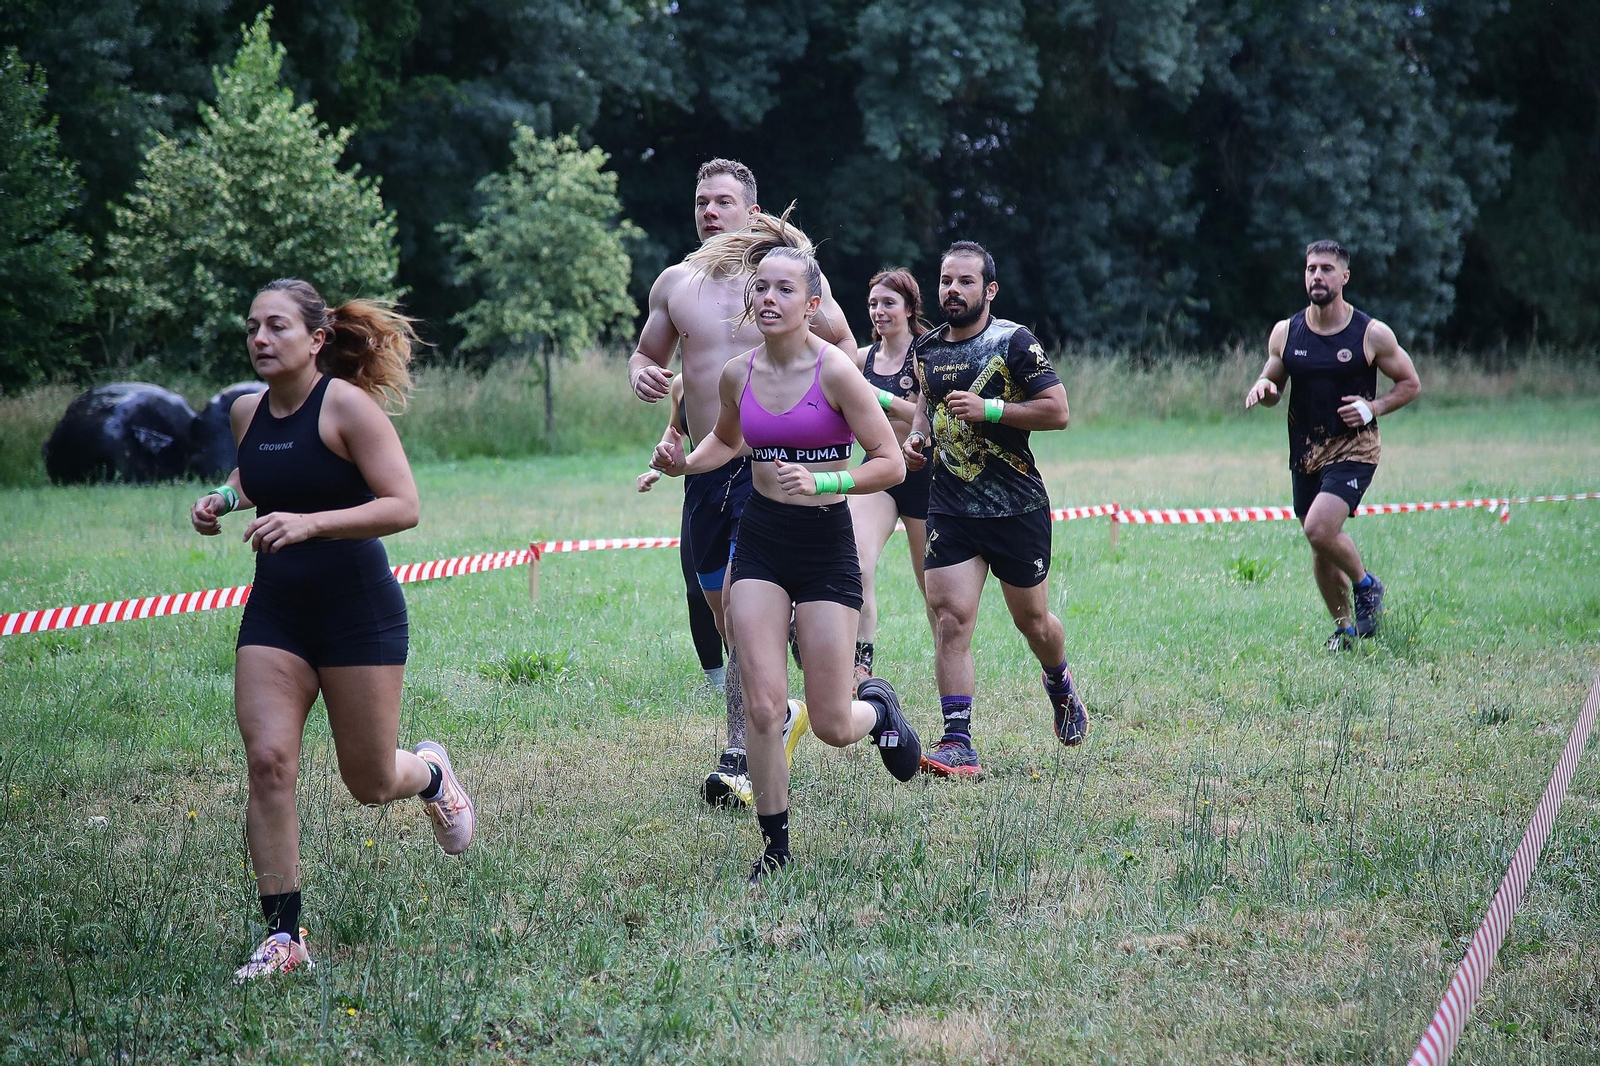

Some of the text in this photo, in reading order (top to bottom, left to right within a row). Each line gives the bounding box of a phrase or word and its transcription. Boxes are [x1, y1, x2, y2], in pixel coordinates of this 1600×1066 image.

[258, 440, 295, 451] CROWNX
[754, 447, 788, 460] PUMA
[796, 447, 839, 460] PUMA
